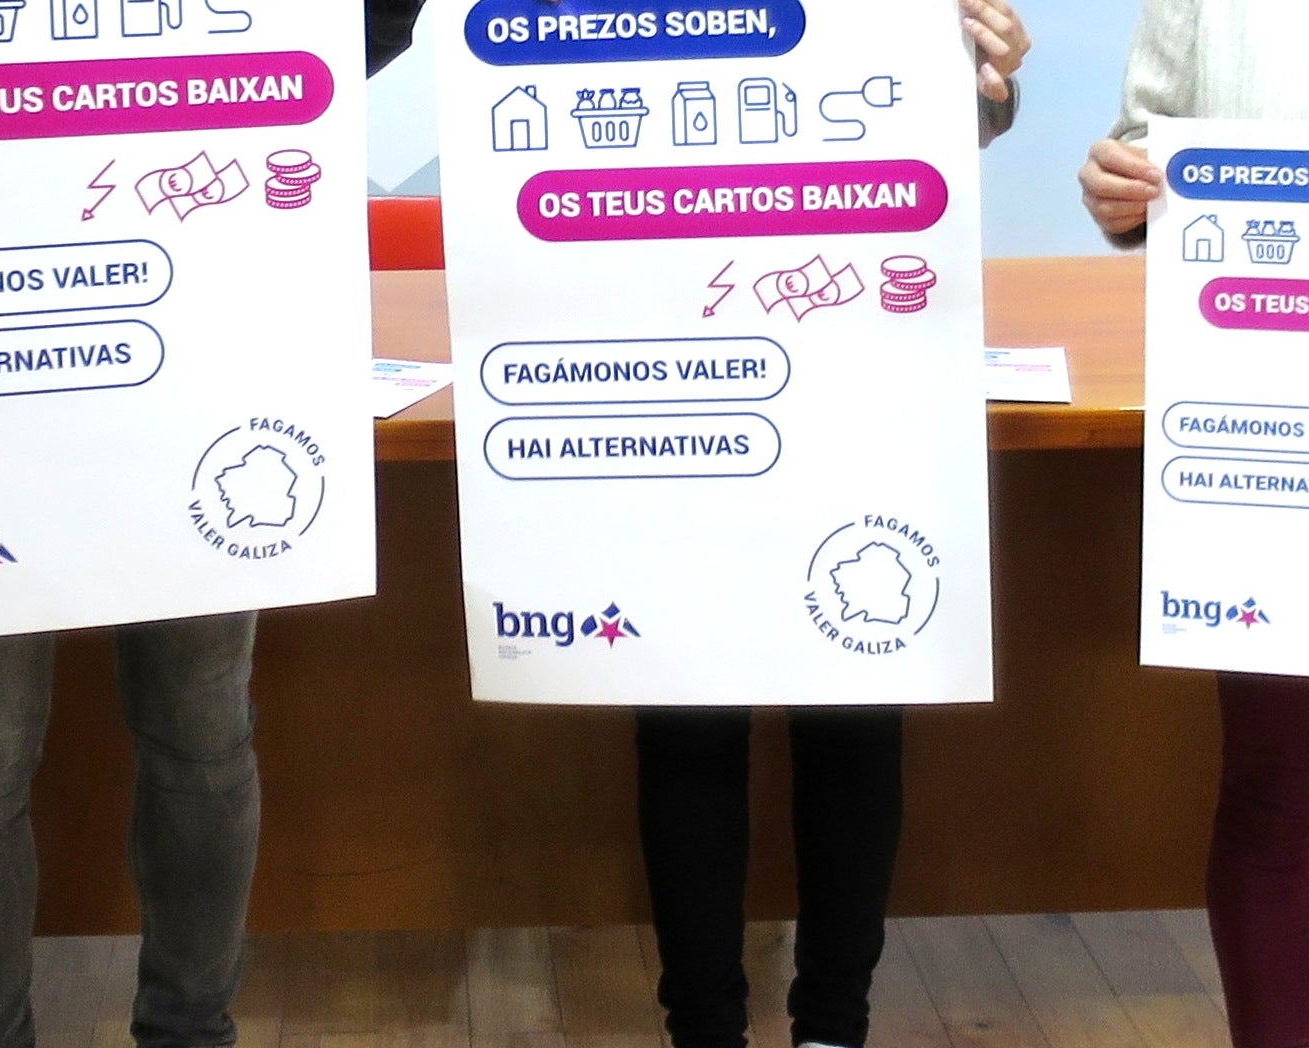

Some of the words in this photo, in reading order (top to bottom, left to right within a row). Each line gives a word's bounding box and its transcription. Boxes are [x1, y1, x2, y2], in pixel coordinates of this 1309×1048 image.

[487, 16, 530, 43] OS
[537, 13, 657, 41] PREZOS
[665, 8, 777, 38] SOBEN,
[52, 82, 178, 113] CARTOS
[186, 76, 303, 104] BAIXAN
[1182, 165, 1213, 184] OS
[1219, 165, 1309, 186] PREZOS
[538, 192, 580, 219] OS
[586, 190, 665, 217] TEUS
[673, 186, 794, 214] CARTOS
[802, 183, 918, 210] BAIXAN
[52, 263, 148, 290] VALER!
[1214, 292, 1245, 312] OS
[1251, 293, 1309, 314] TEUS
[503, 357, 668, 385] FAGÁMONOS
[675, 357, 768, 381] VALER!
[249, 417, 325, 466] FAGAMOS
[1179, 415, 1305, 439] FAGÁMONOS
[507, 439, 552, 459] HAI
[559, 434, 750, 459] ALTERNATIVAS
[1179, 472, 1213, 488] HAI
[188, 500, 225, 549] VALER
[227, 540, 292, 559] GALIZA
[864, 514, 940, 567] FAGAMOS
[492, 601, 575, 647] bng
[804, 591, 839, 641] VALER
[842, 637, 906, 655] GALIZA
[1160, 590, 1221, 627] bng
